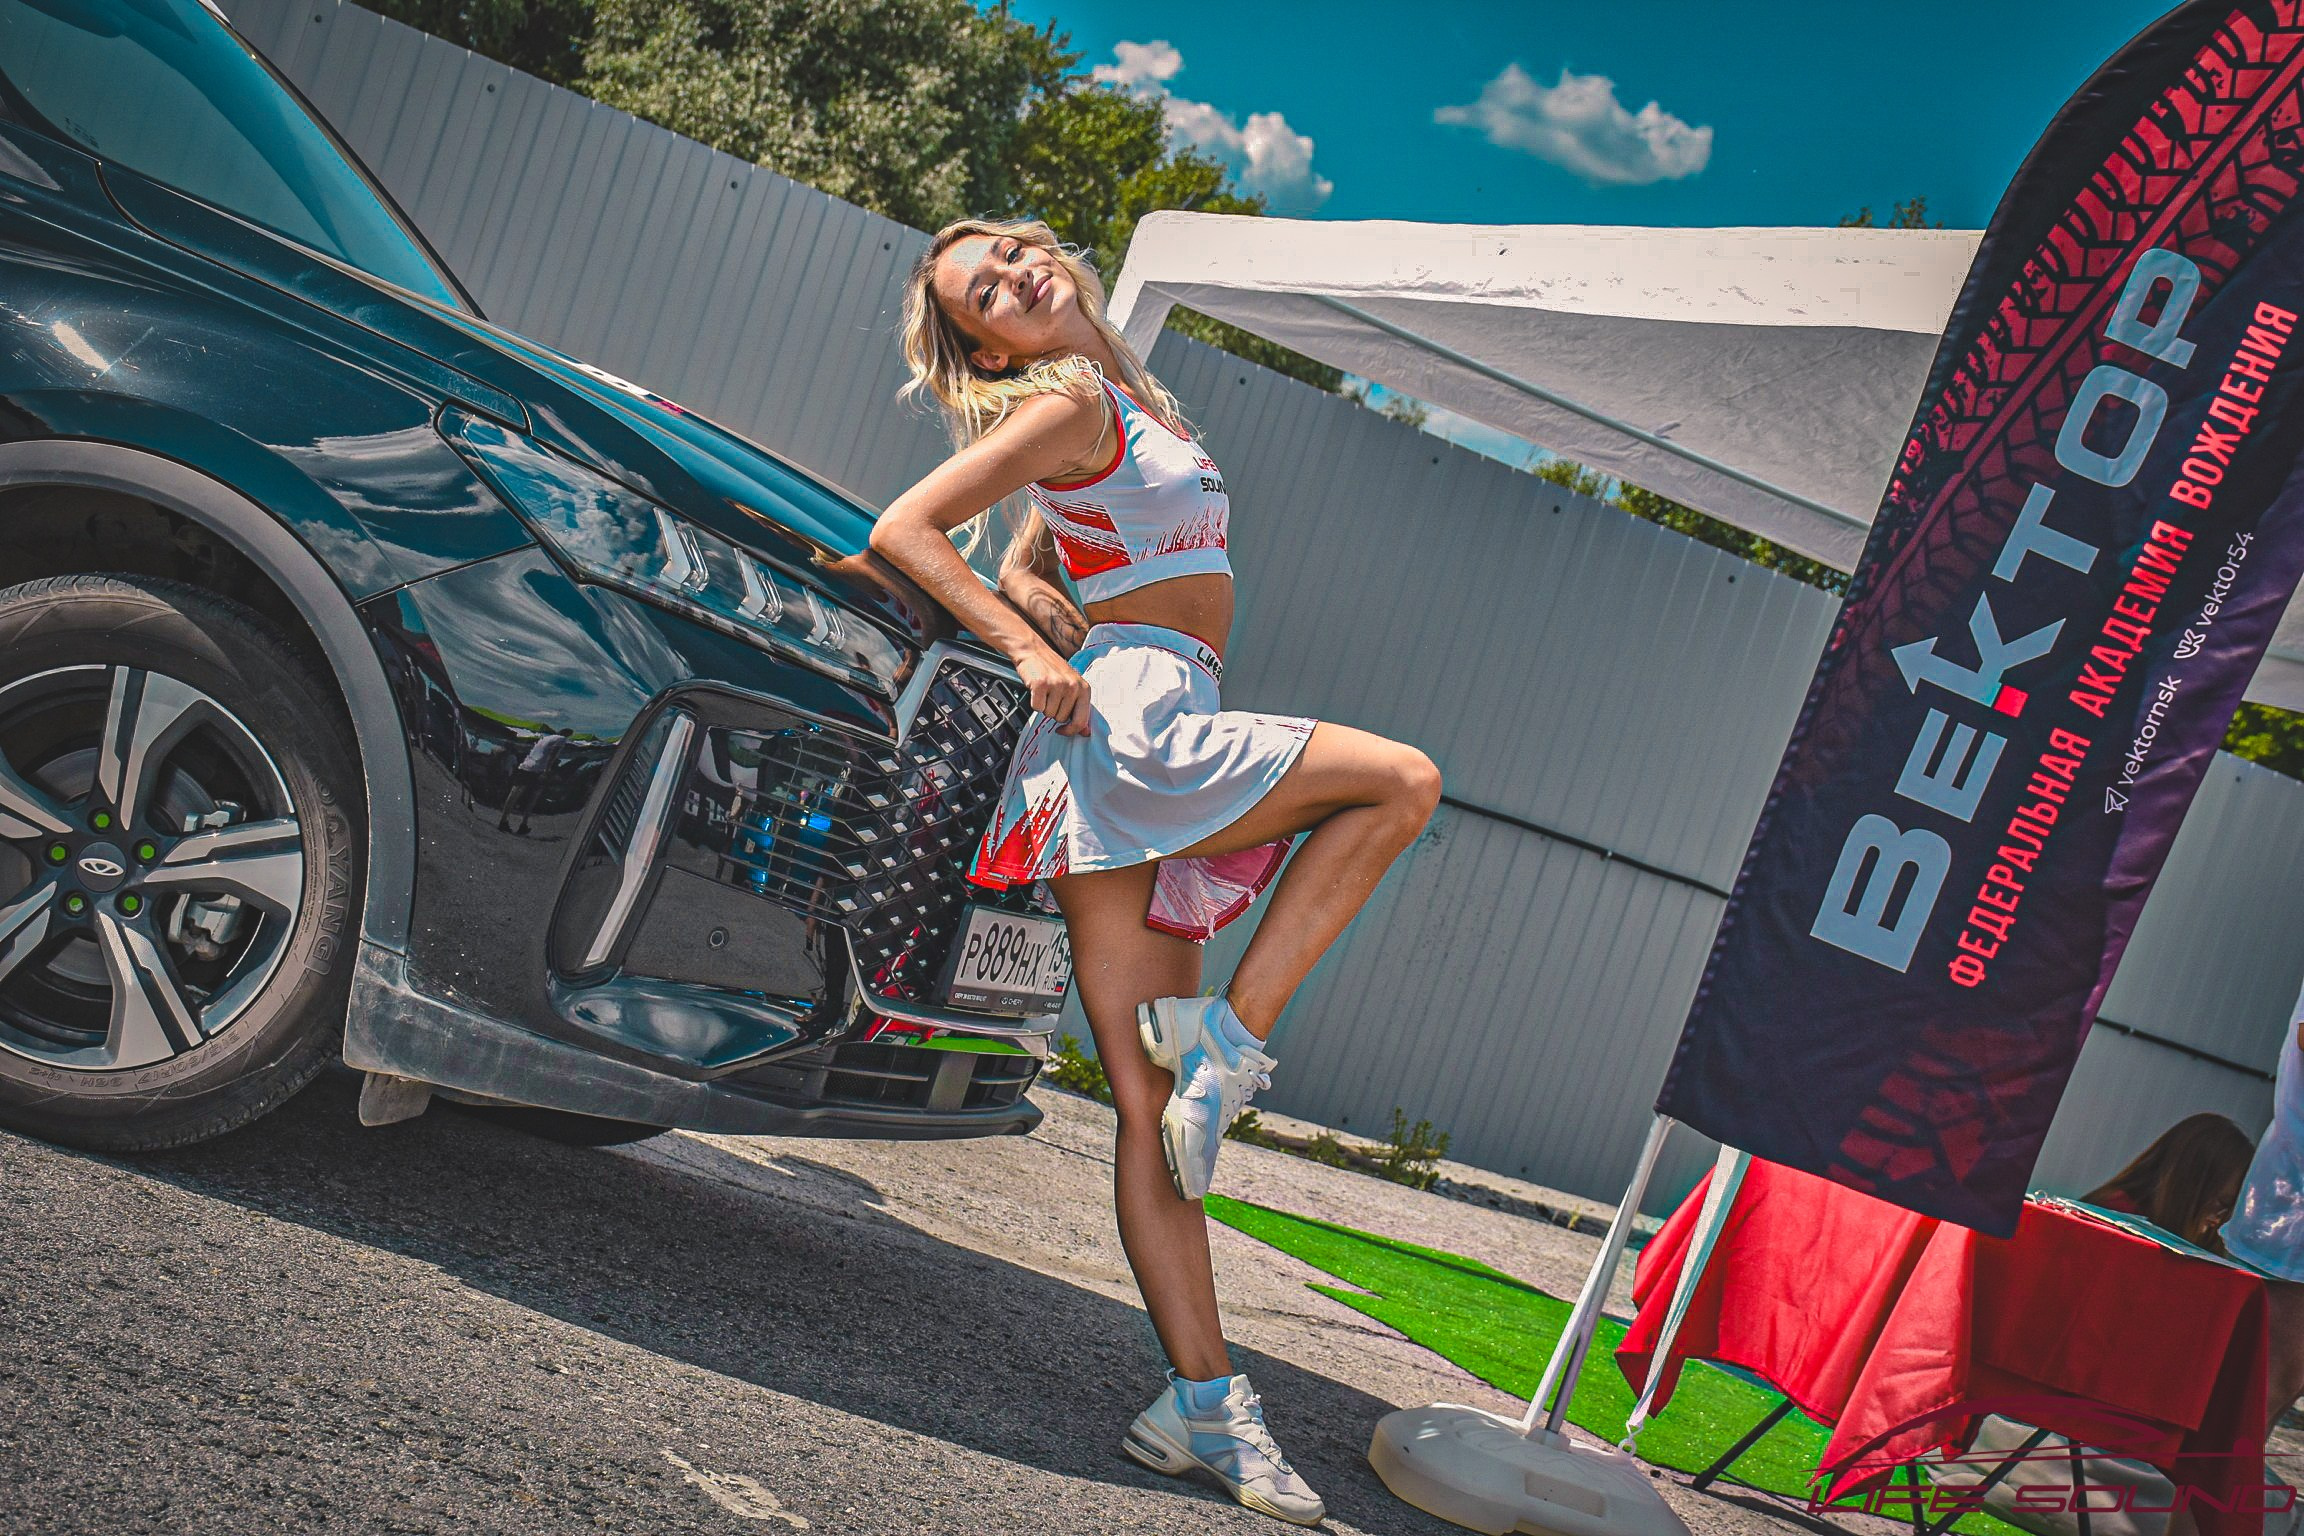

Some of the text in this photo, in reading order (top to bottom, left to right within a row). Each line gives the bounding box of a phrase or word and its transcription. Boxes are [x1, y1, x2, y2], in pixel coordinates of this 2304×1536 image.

[1200, 476, 1227, 495] SOUN
[1810, 248, 2201, 973] ВЕКТОР
[1948, 301, 2298, 988] ФЕДЕРАЛЬНАЯ АКАДЕМИЯ ВОЖДЕНИЯ
[2118, 675, 2182, 785] vektornsk
[1043, 974, 1058, 991] RUS
